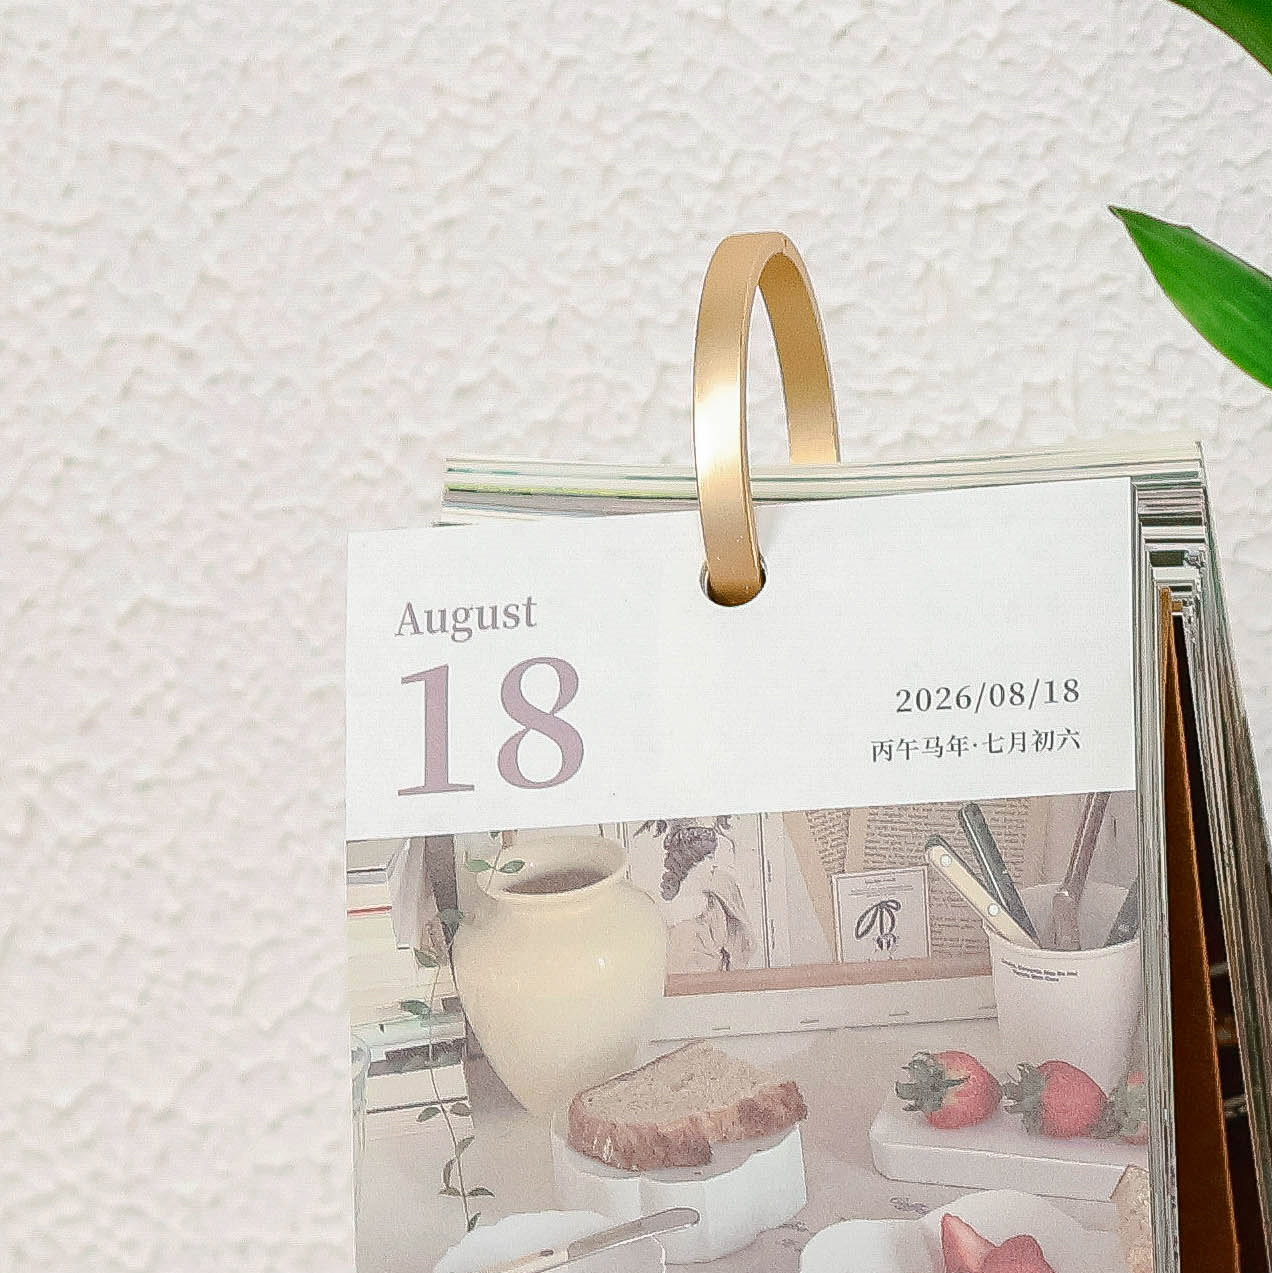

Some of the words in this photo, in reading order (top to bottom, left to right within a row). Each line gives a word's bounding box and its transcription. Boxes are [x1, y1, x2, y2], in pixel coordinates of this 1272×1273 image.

[395, 595, 538, 643] August
[895, 678, 1080, 714] 2026/08/18
[397, 656, 585, 797] 18
[870, 728, 1081, 763] 丙午马年·七月初六
